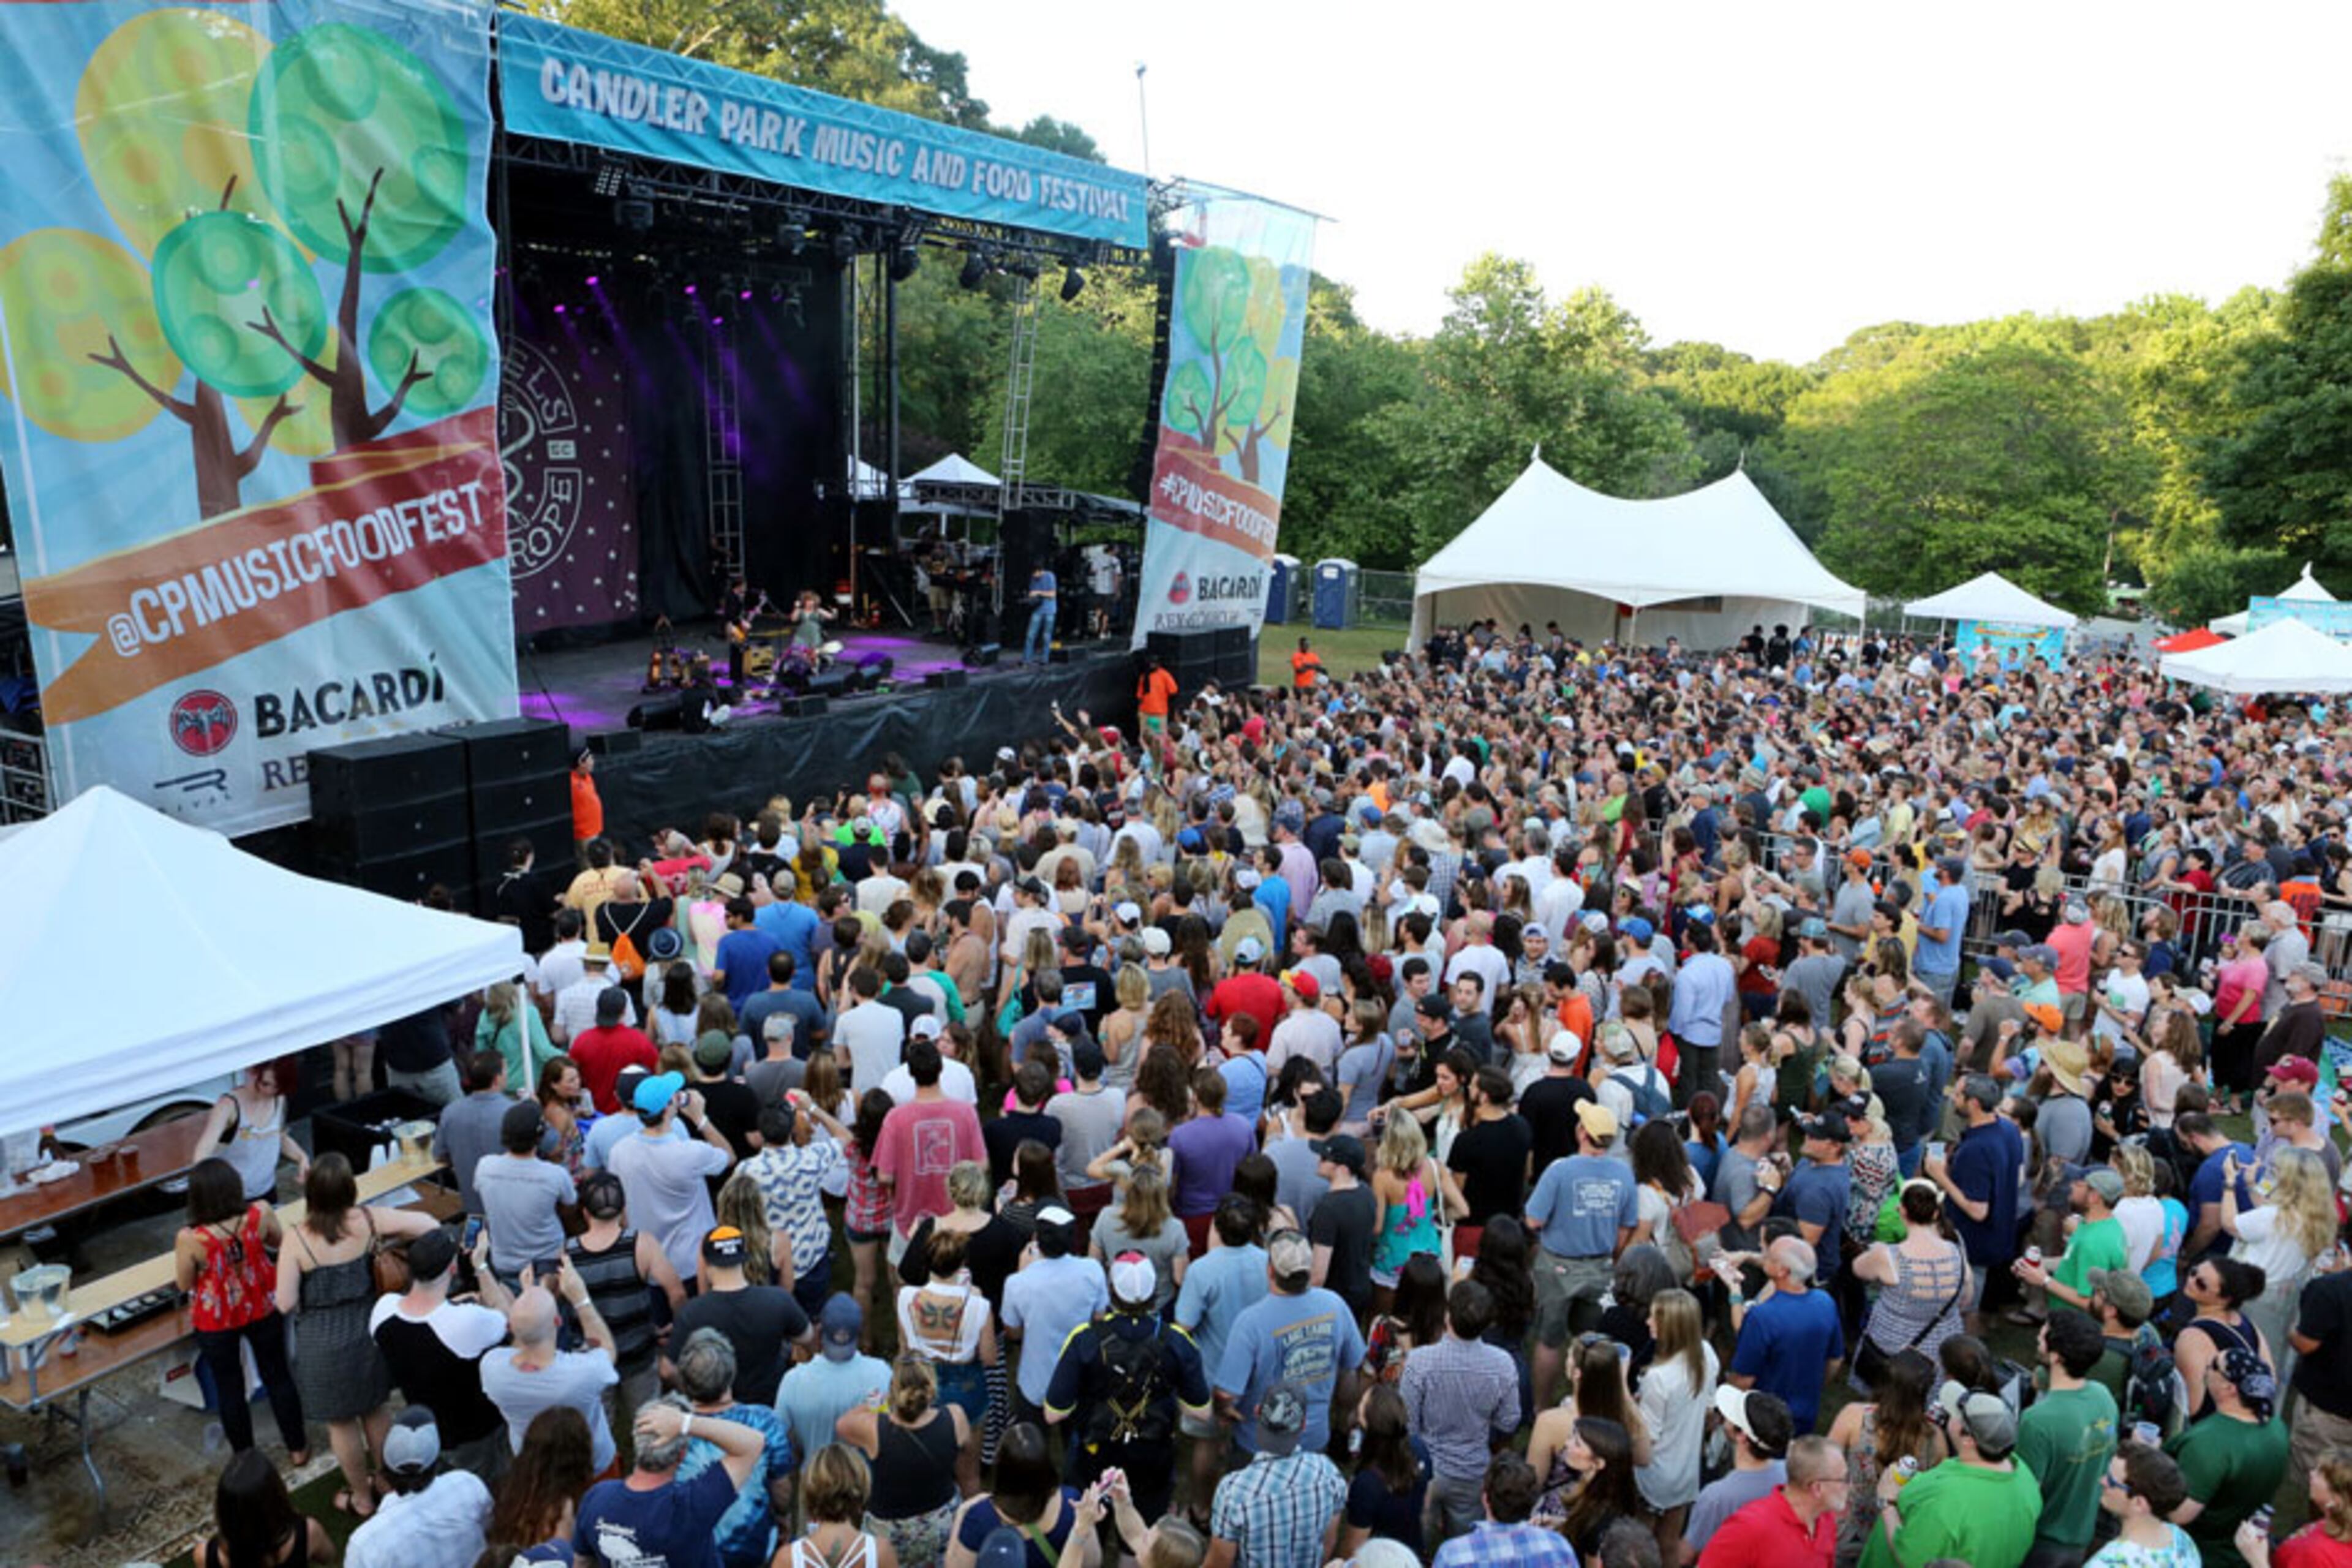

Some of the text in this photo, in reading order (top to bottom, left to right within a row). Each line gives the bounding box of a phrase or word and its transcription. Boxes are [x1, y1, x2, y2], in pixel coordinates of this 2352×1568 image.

[540, 57, 1129, 222] CANDLER PARK MUSIC AND FOOD FESTIVAL
[107, 480, 485, 658] @CPMUSICFOODFEST
[255, 652, 447, 738] BACARDÍ
